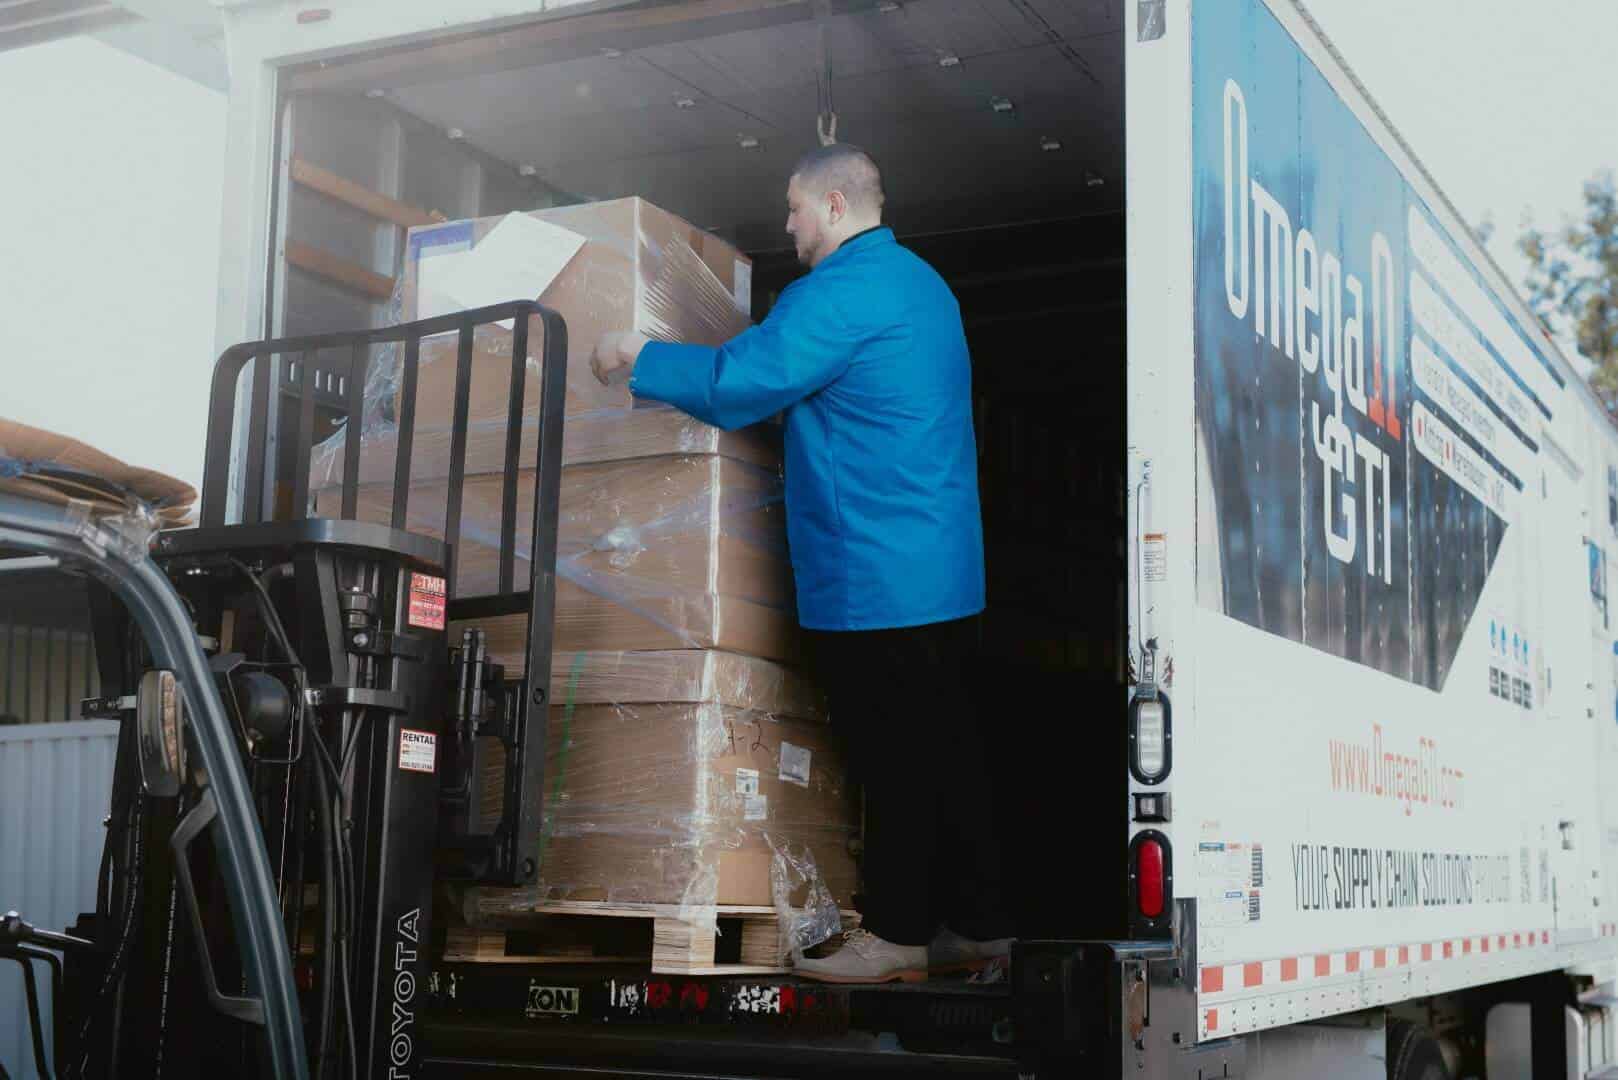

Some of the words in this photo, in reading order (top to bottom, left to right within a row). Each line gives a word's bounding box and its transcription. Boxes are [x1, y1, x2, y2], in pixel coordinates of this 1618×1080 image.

[402, 732, 435, 745] RENTAL
[1290, 842, 1330, 911] YOUR
[1332, 846, 1383, 910] SUPPLY
[1385, 849, 1419, 908] CHAIN
[1422, 851, 1474, 906] SOLUTIONS
